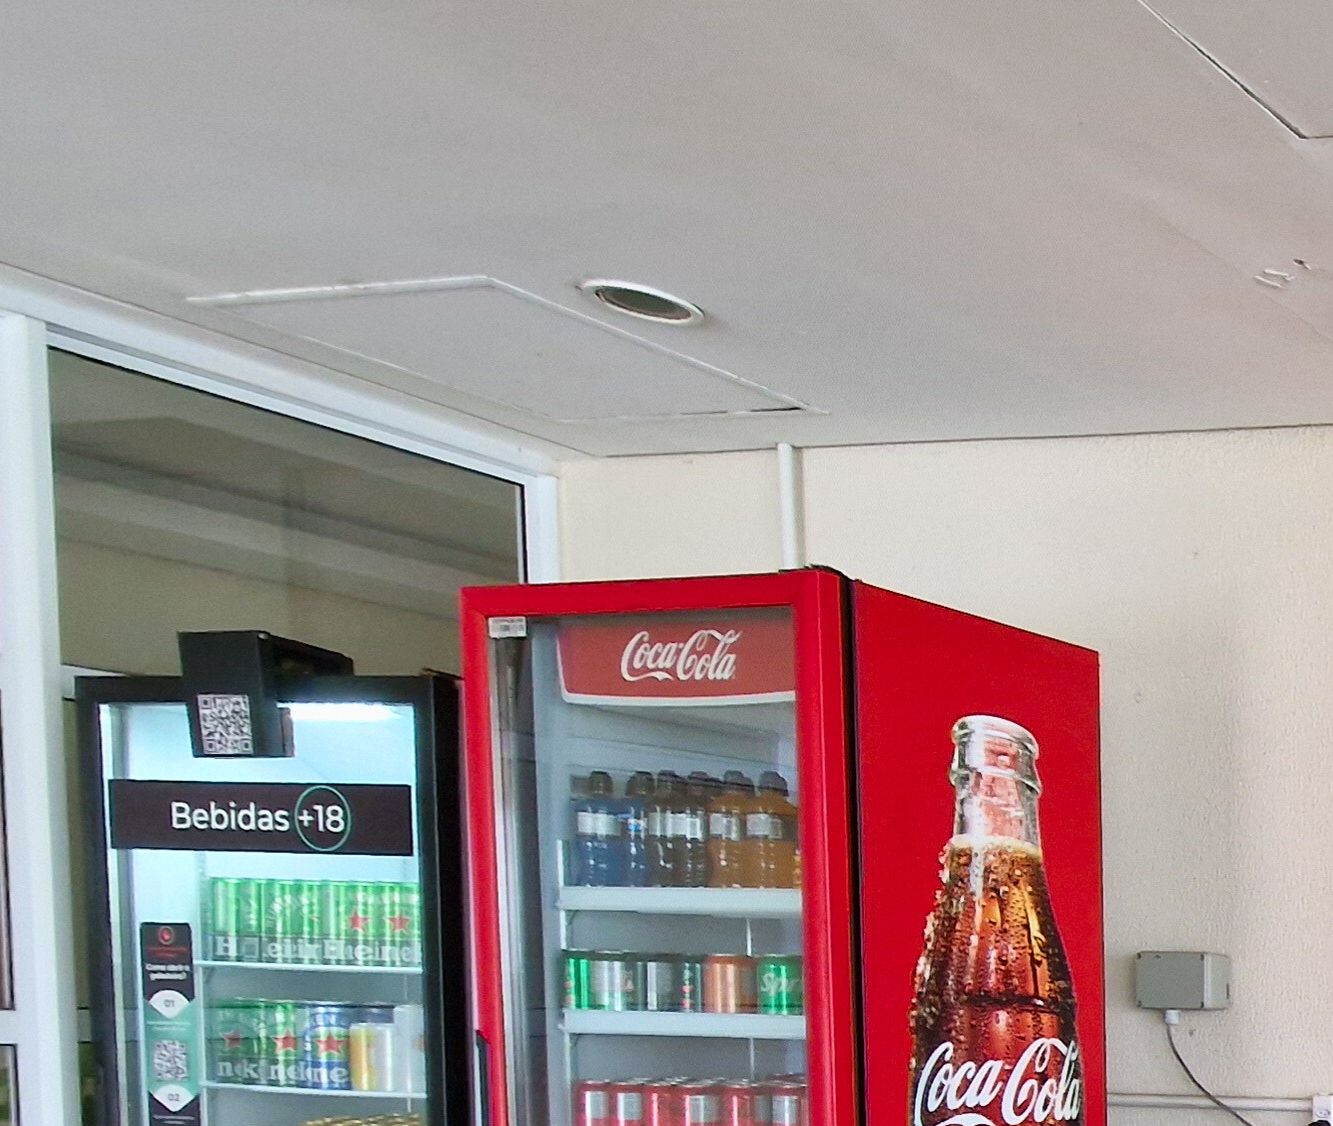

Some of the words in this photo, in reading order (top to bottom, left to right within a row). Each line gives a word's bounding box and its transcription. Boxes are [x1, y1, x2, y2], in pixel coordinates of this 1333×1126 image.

[170, 801, 290, 832] Bebidas
[298, 804, 346, 833] +18
[167, 1093, 181, 1102] 02
